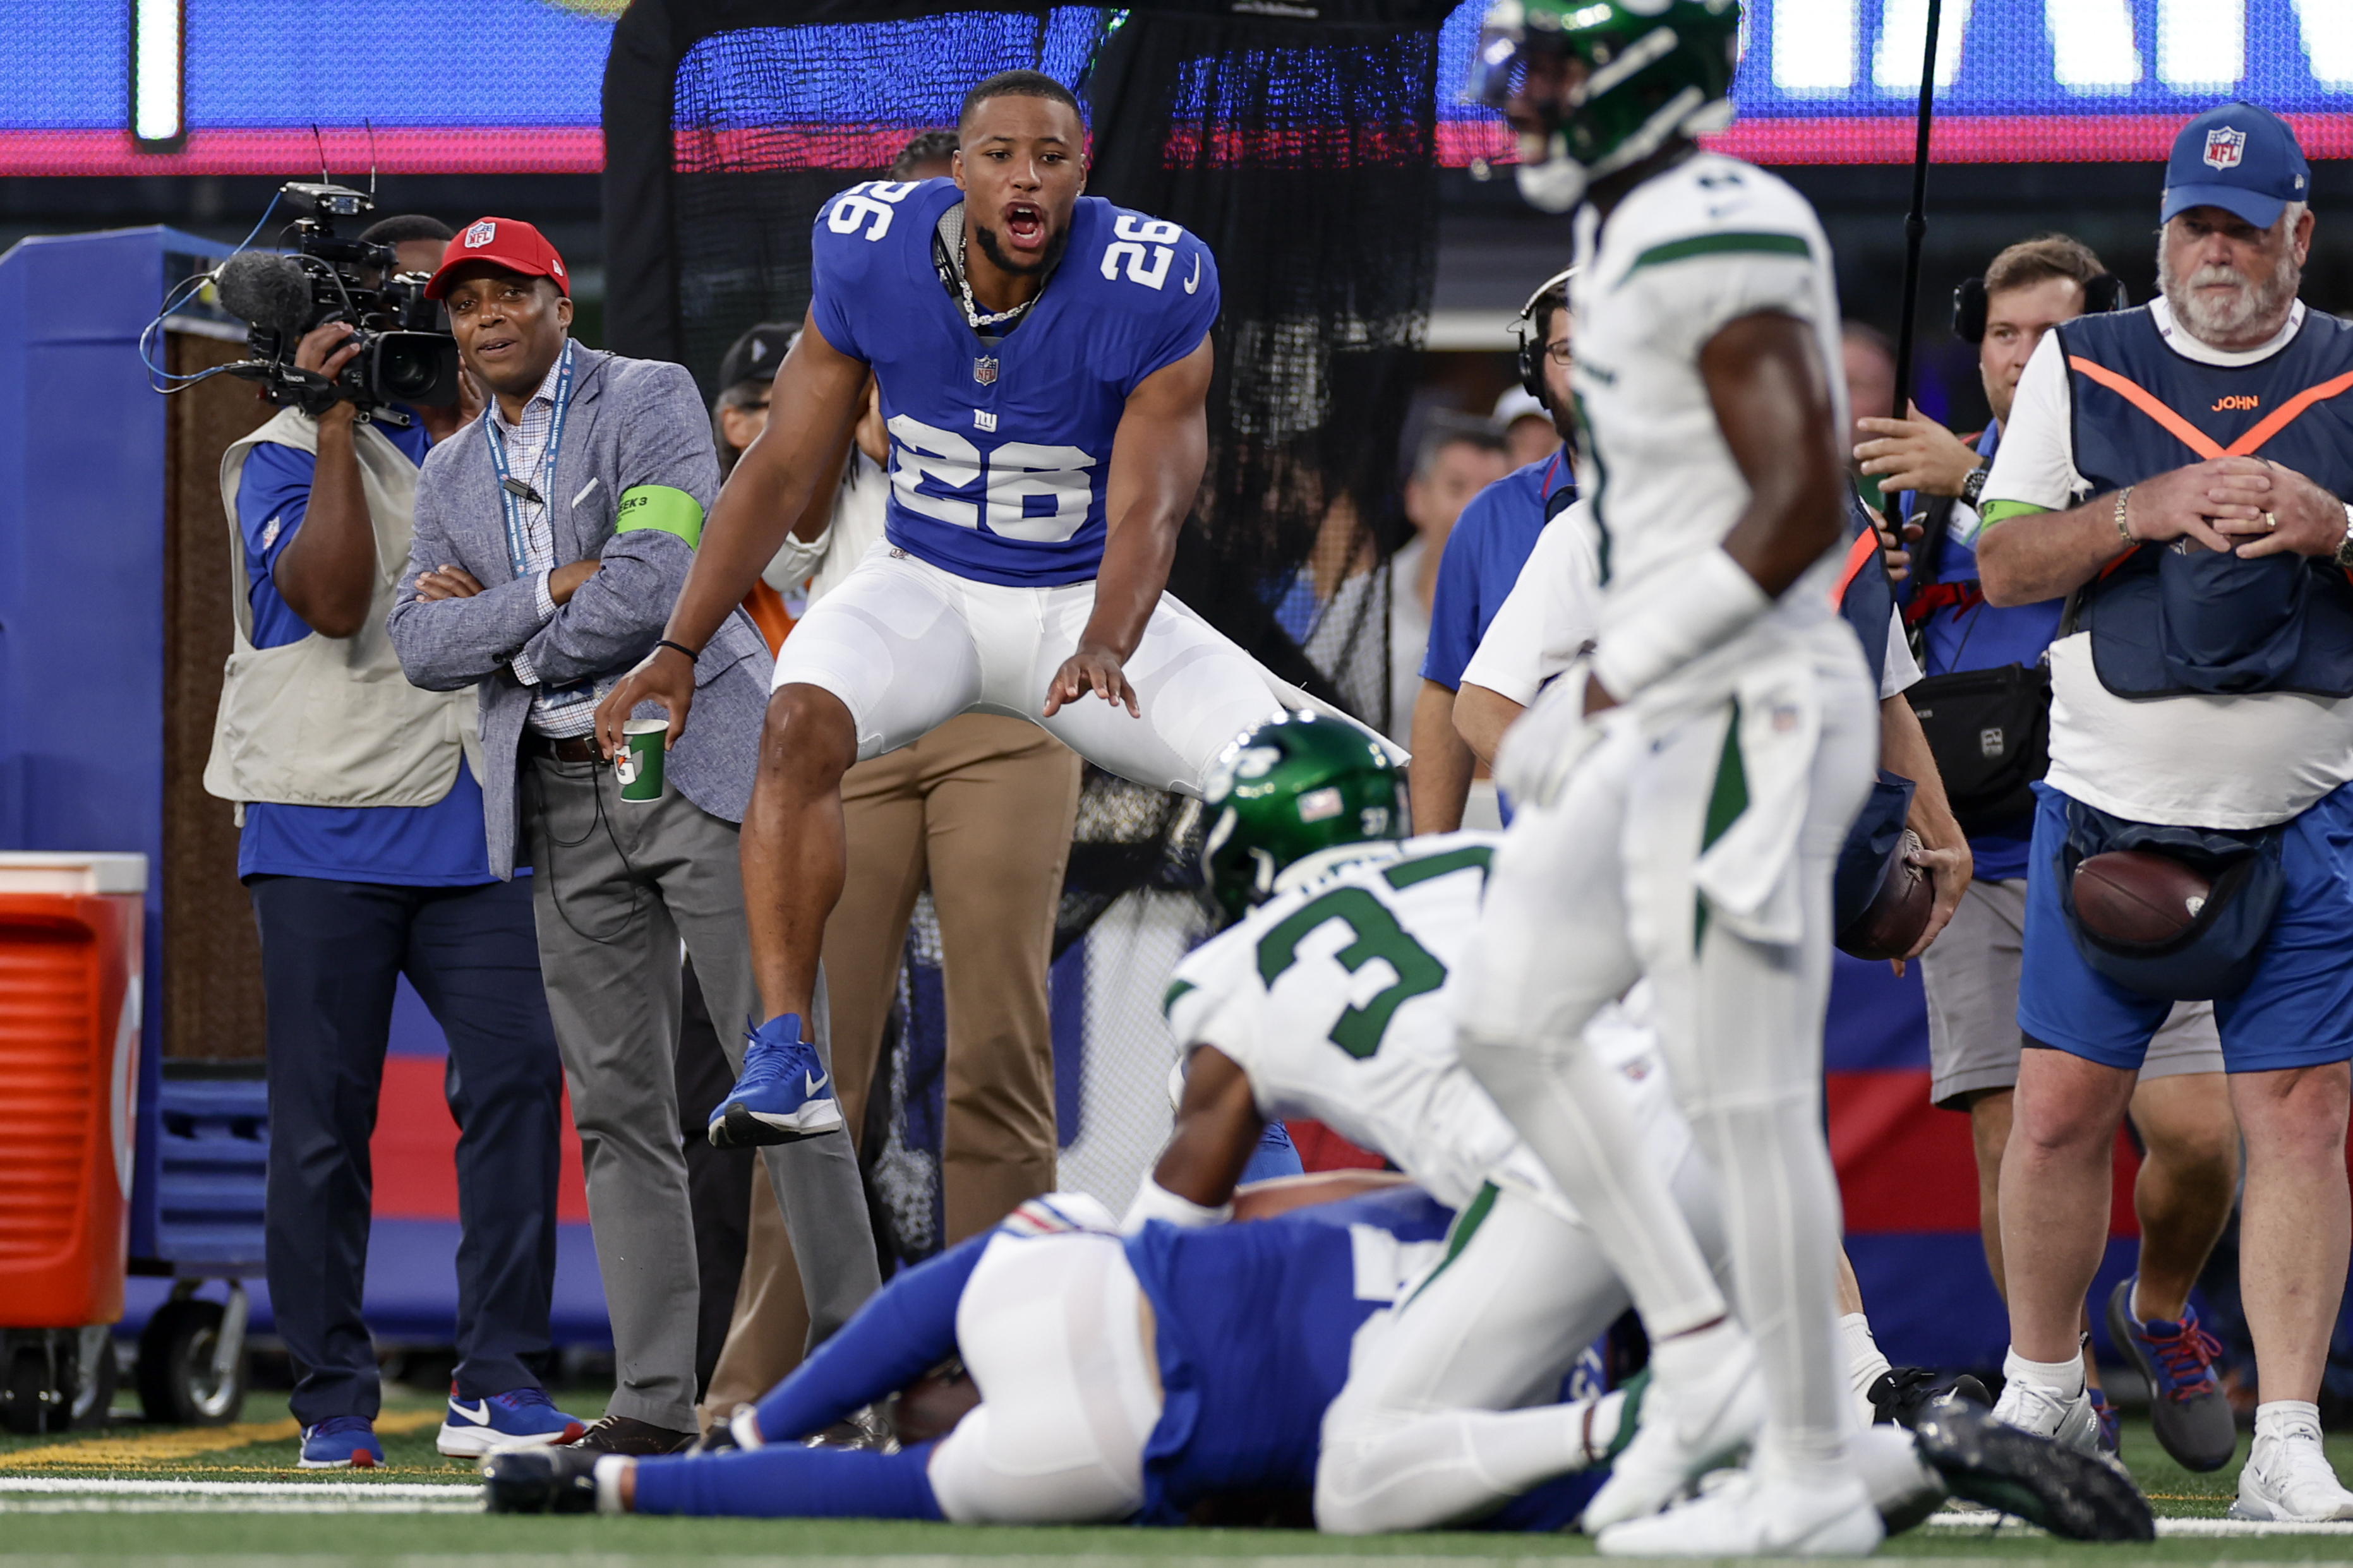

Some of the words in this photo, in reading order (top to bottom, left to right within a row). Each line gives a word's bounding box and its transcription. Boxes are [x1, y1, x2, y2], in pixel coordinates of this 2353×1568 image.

[2208, 143, 2237, 163] NFL
[827, 180, 922, 242] 26
[469, 231, 490, 245] NFL
[1100, 215, 1183, 290] 26
[977, 369, 996, 380] NFL
[558, 380, 567, 402] NATIONAL
[2212, 395, 2259, 412] JOHN
[554, 403, 563, 429] FOOTBALL
[550, 429, 558, 450] LEAGUE
[887, 413, 1097, 543] 26
[639, 497, 647, 506] 3
[507, 506, 516, 534] FOOTBALL
